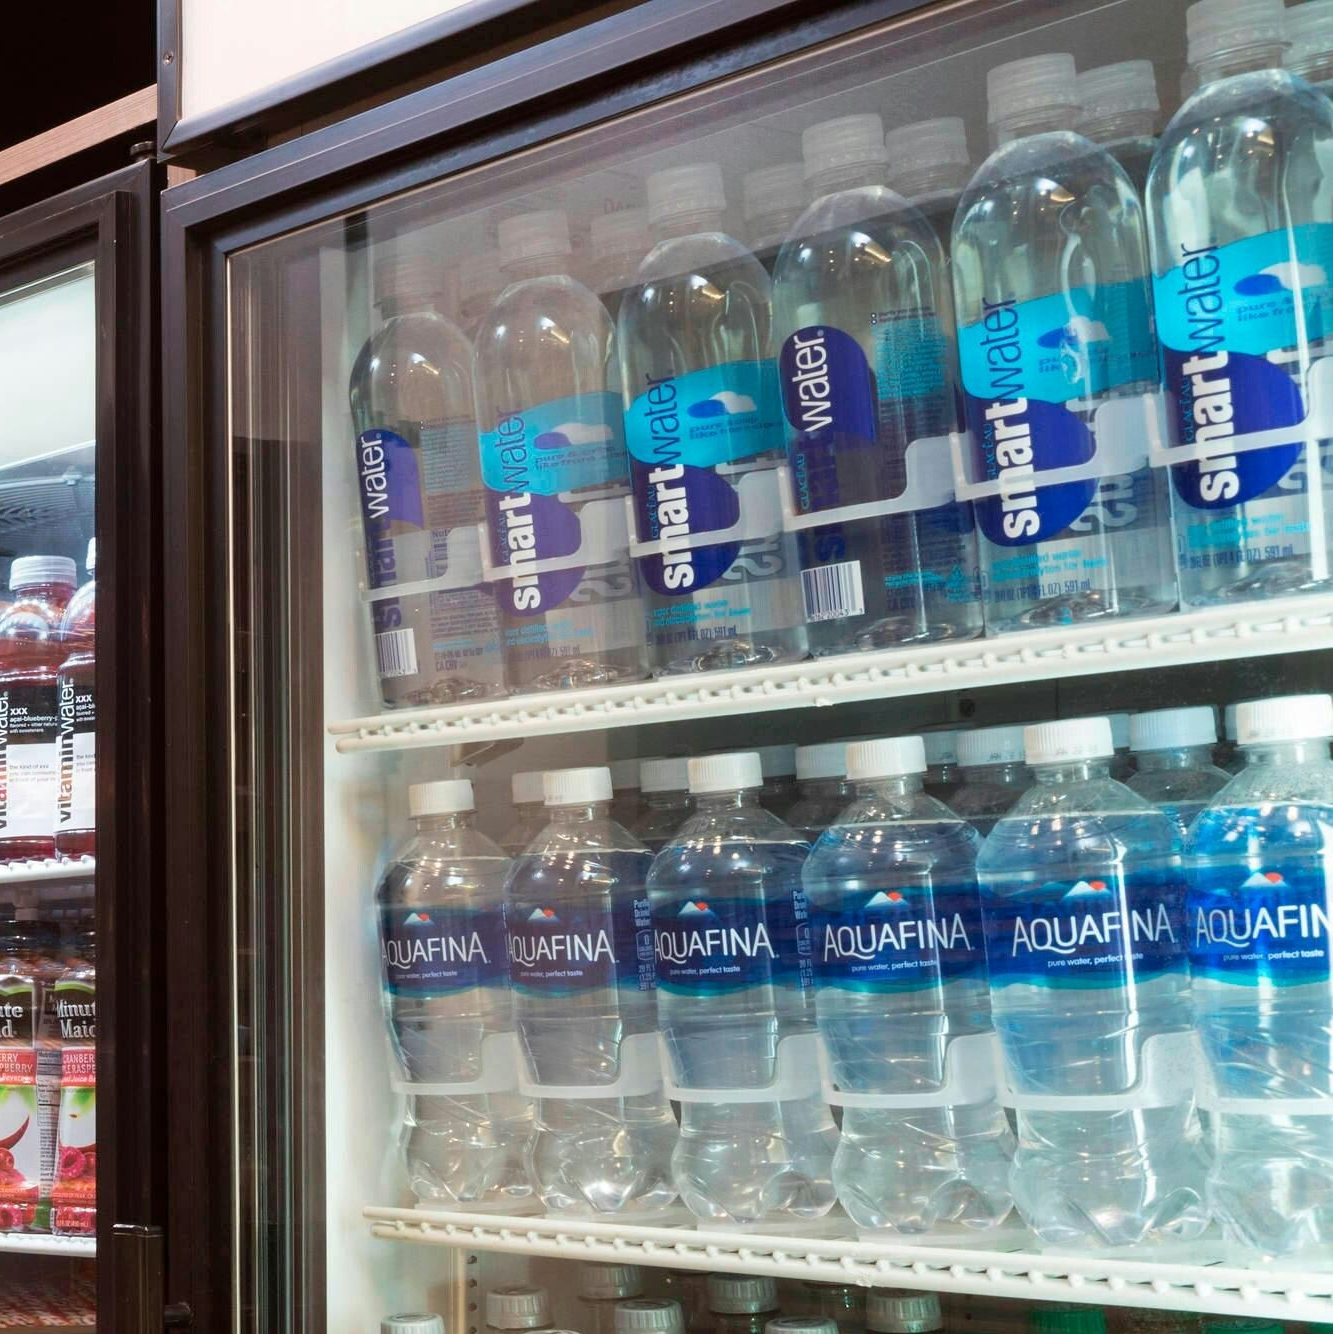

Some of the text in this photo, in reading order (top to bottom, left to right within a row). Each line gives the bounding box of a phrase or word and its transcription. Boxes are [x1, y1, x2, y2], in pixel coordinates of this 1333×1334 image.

[792, 333, 833, 433] water
[362, 434, 383, 519] water
[10, 707, 28, 715] xxx
[76, 694, 92, 702] xxx
[59, 681, 75, 823] vitaminwater
[508, 929, 616, 969] AQUAFINA
[654, 922, 776, 969] AQUAFINA
[824, 913, 973, 961] AQUAFINA
[1012, 903, 1175, 956] AQUAFNA
[382, 931, 489, 970] AQUAFINA
[892, 961, 919, 970] perfect
[1048, 960, 1065, 968] pure
[1268, 950, 1324, 960] perfect taste
[699, 967, 722, 975] perfect
